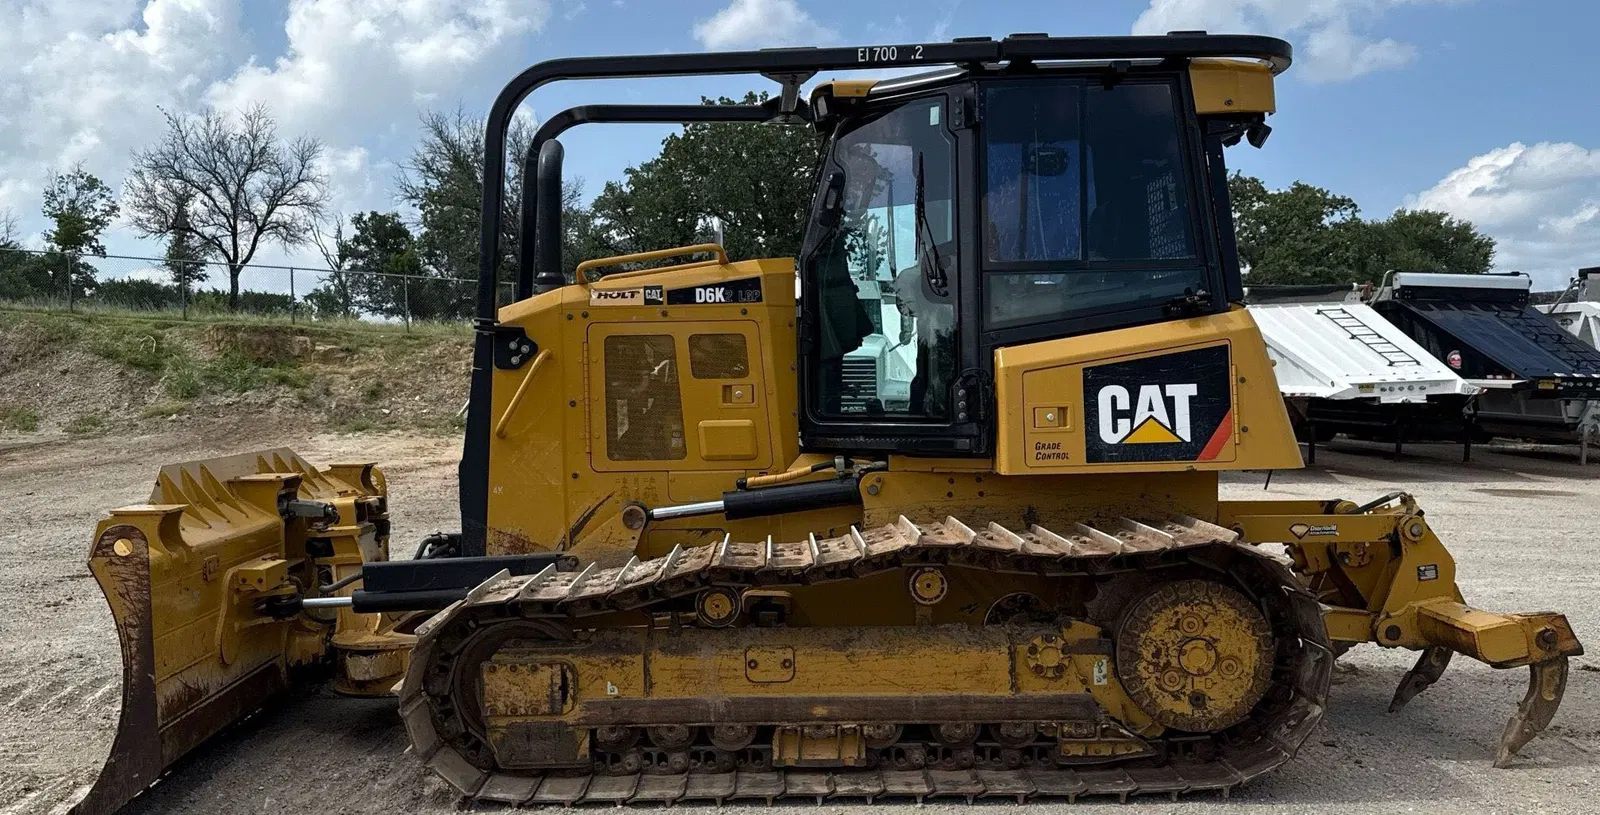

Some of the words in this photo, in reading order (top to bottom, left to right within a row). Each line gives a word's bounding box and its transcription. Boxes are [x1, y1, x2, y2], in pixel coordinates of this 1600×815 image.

[597, 290, 640, 299] HOLT
[645, 289, 663, 301] CAT
[1097, 383, 1198, 444] CAT
